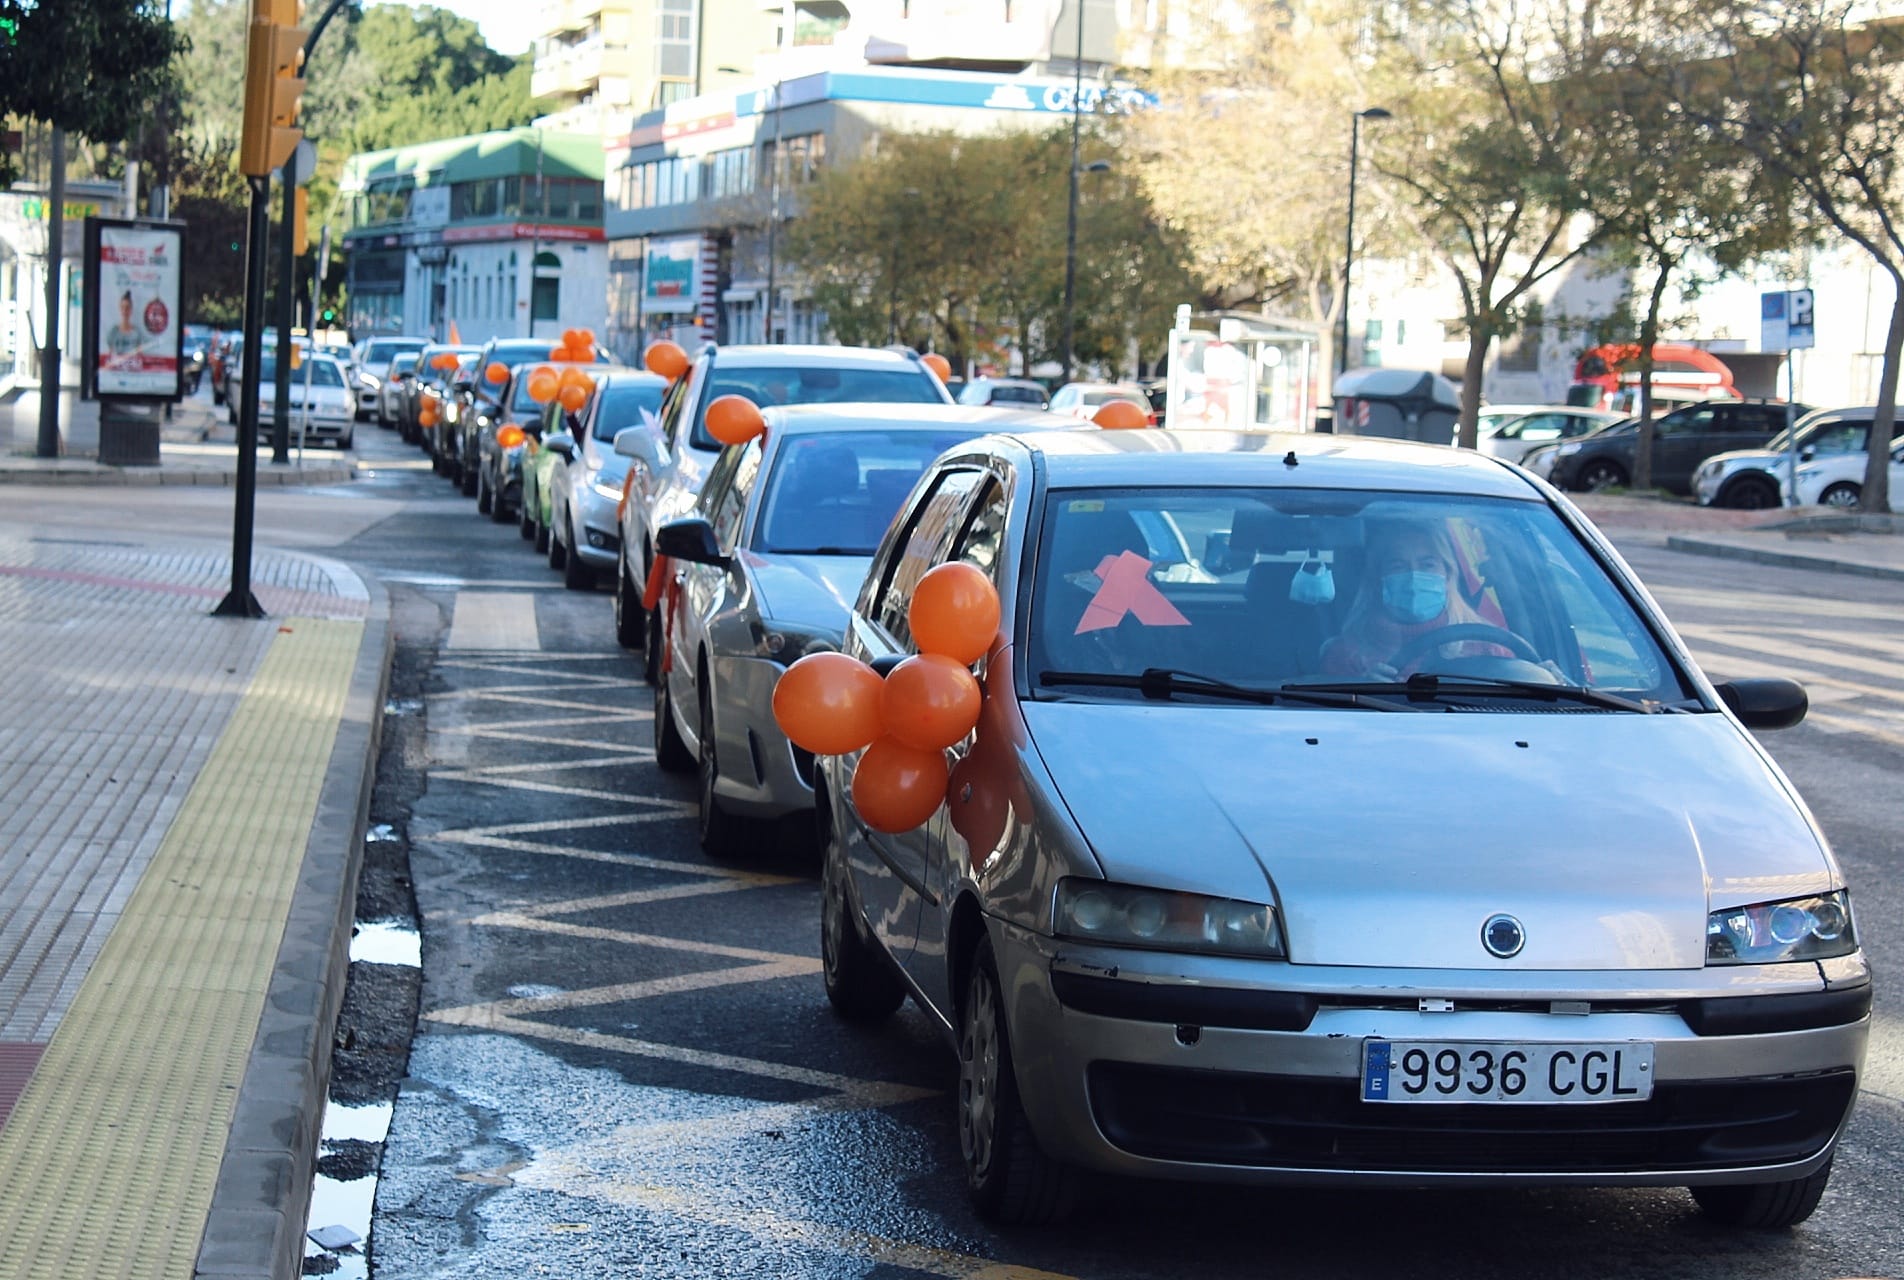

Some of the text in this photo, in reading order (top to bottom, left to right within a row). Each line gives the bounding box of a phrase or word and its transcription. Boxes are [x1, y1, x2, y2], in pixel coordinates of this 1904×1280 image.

[1790, 291, 1812, 324] P
[1371, 1078, 1382, 1091] E
[1402, 1049, 1638, 1095] 9936 CGL
